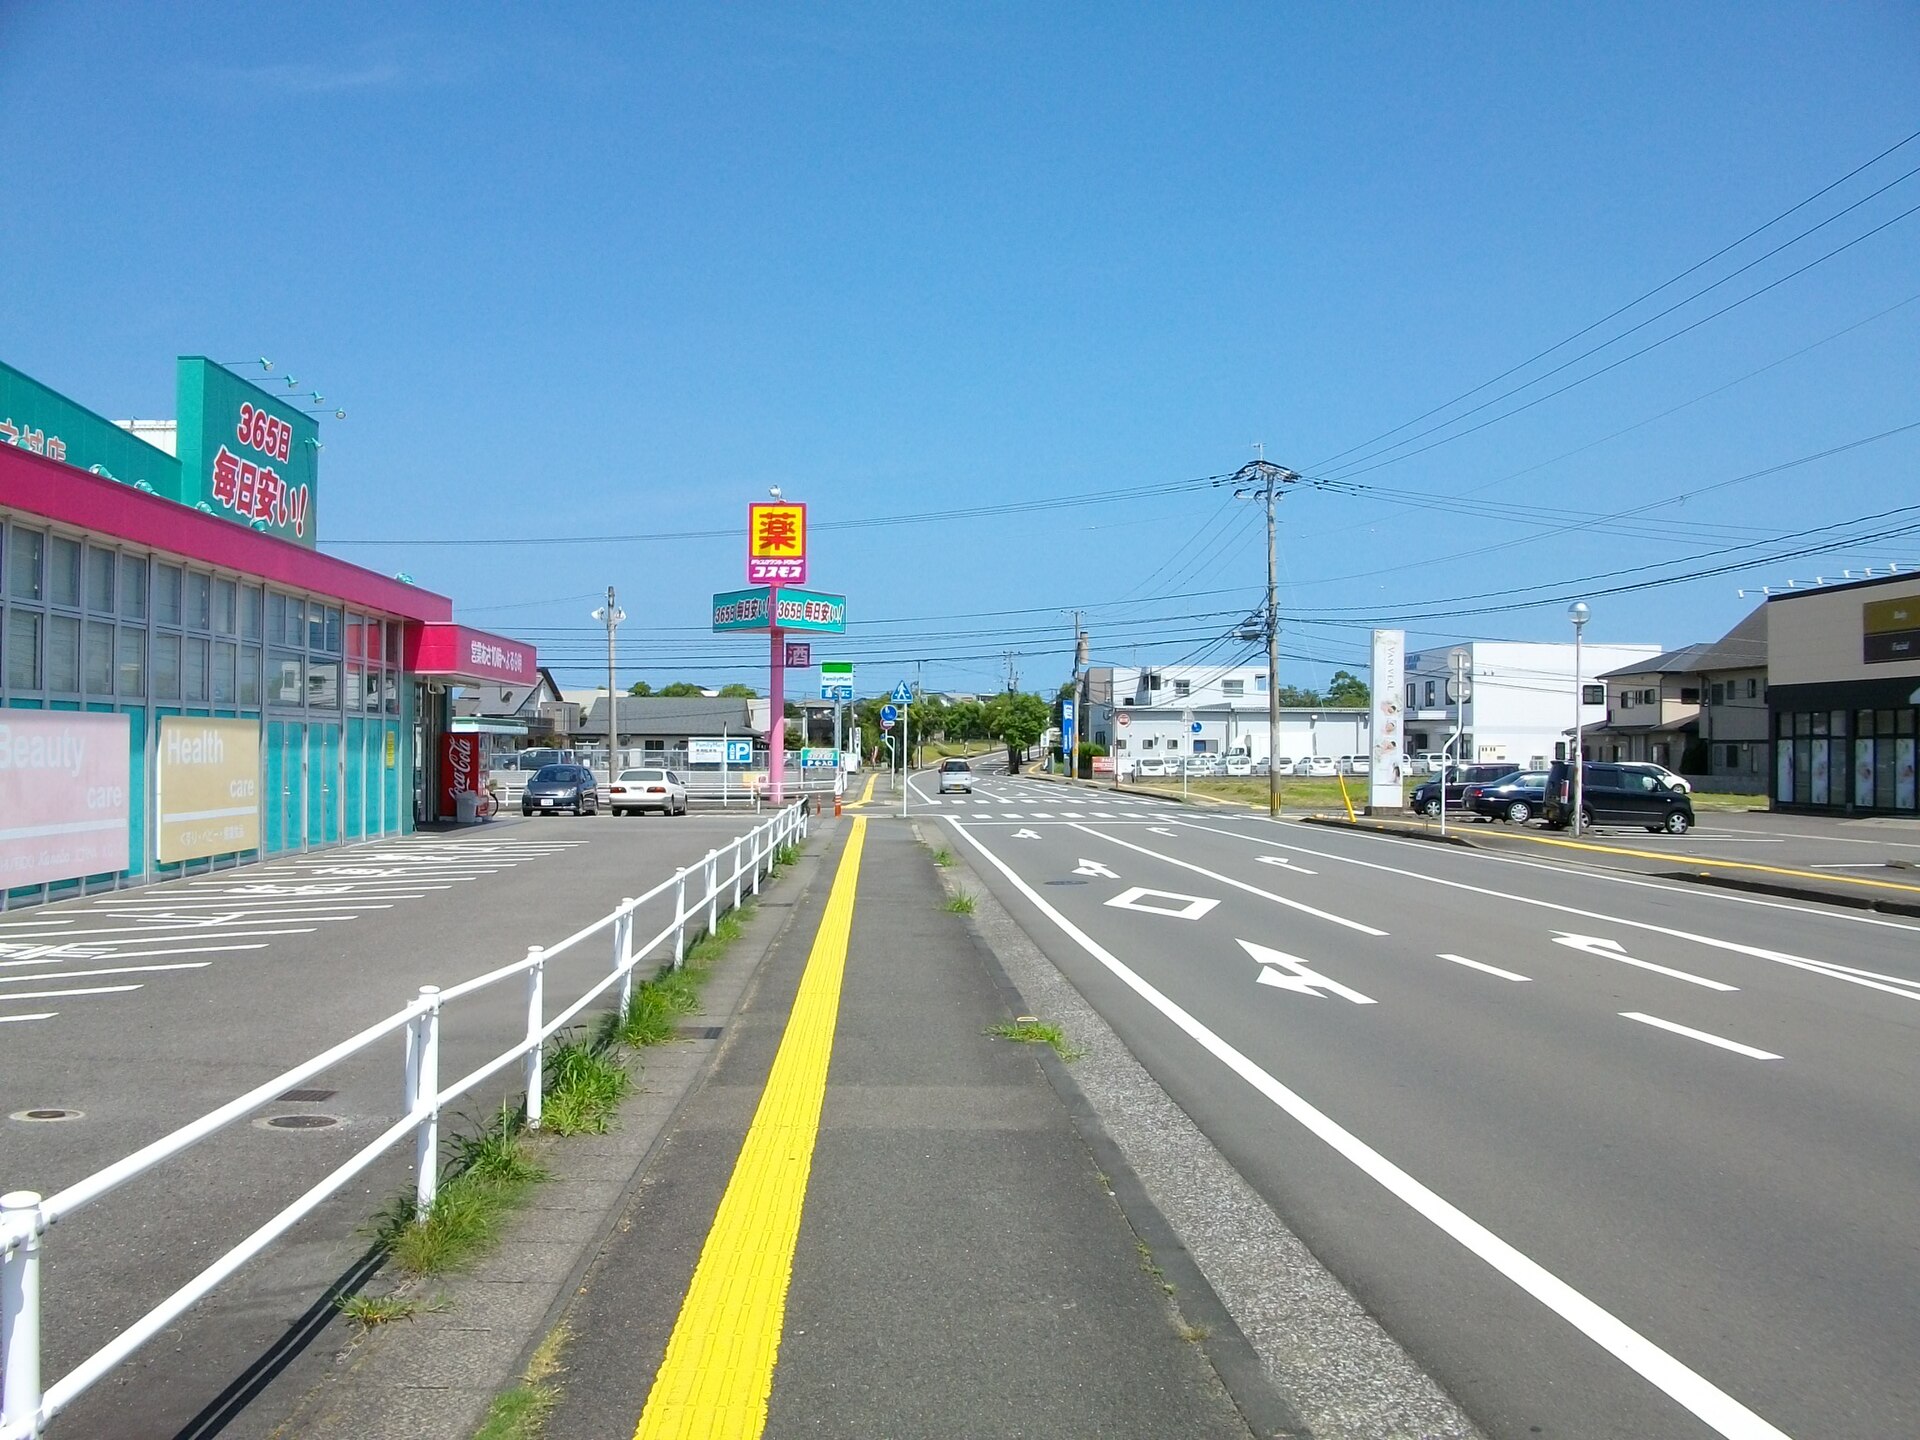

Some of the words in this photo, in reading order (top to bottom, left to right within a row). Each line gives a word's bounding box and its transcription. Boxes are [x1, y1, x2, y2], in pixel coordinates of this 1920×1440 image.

[237, 401, 293, 464] 365日
[758, 511, 796, 551] 薬
[752, 566, 802, 578] コスモス
[714, 604, 735, 625] 365日
[777, 601, 803, 620] 365日
[787, 645, 809, 666] 酒
[822, 675, 851, 684] FamilyMart
[0, 723, 86, 777] Beauty
[167, 729, 223, 765] Health
[735, 743, 750, 760] P
[87, 785, 122, 810] care
[230, 779, 254, 798] care
